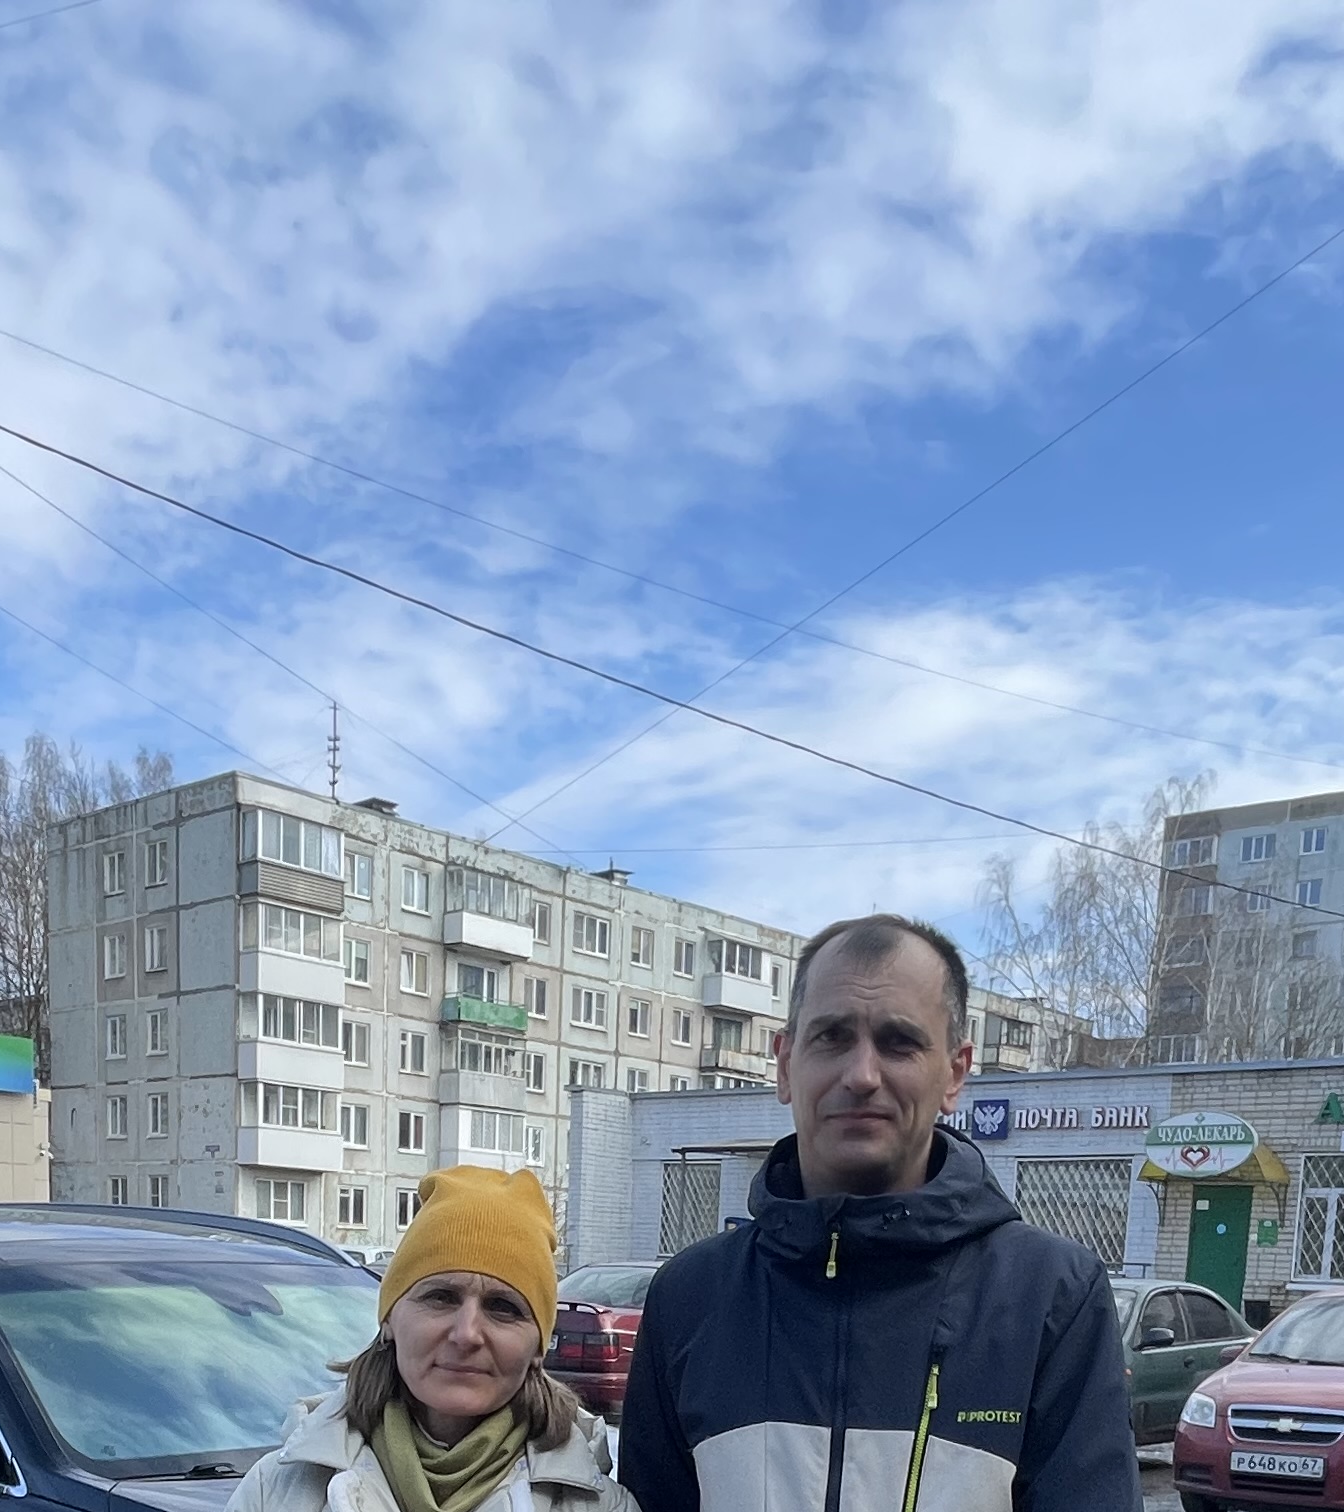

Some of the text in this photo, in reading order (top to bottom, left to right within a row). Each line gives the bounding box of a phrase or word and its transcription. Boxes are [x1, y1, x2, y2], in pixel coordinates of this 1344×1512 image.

[1014, 1105, 1150, 1129] ПОЧТА БАНК
[1158, 1125, 1246, 1143] ЧУДО-ЛЕКАРЬ
